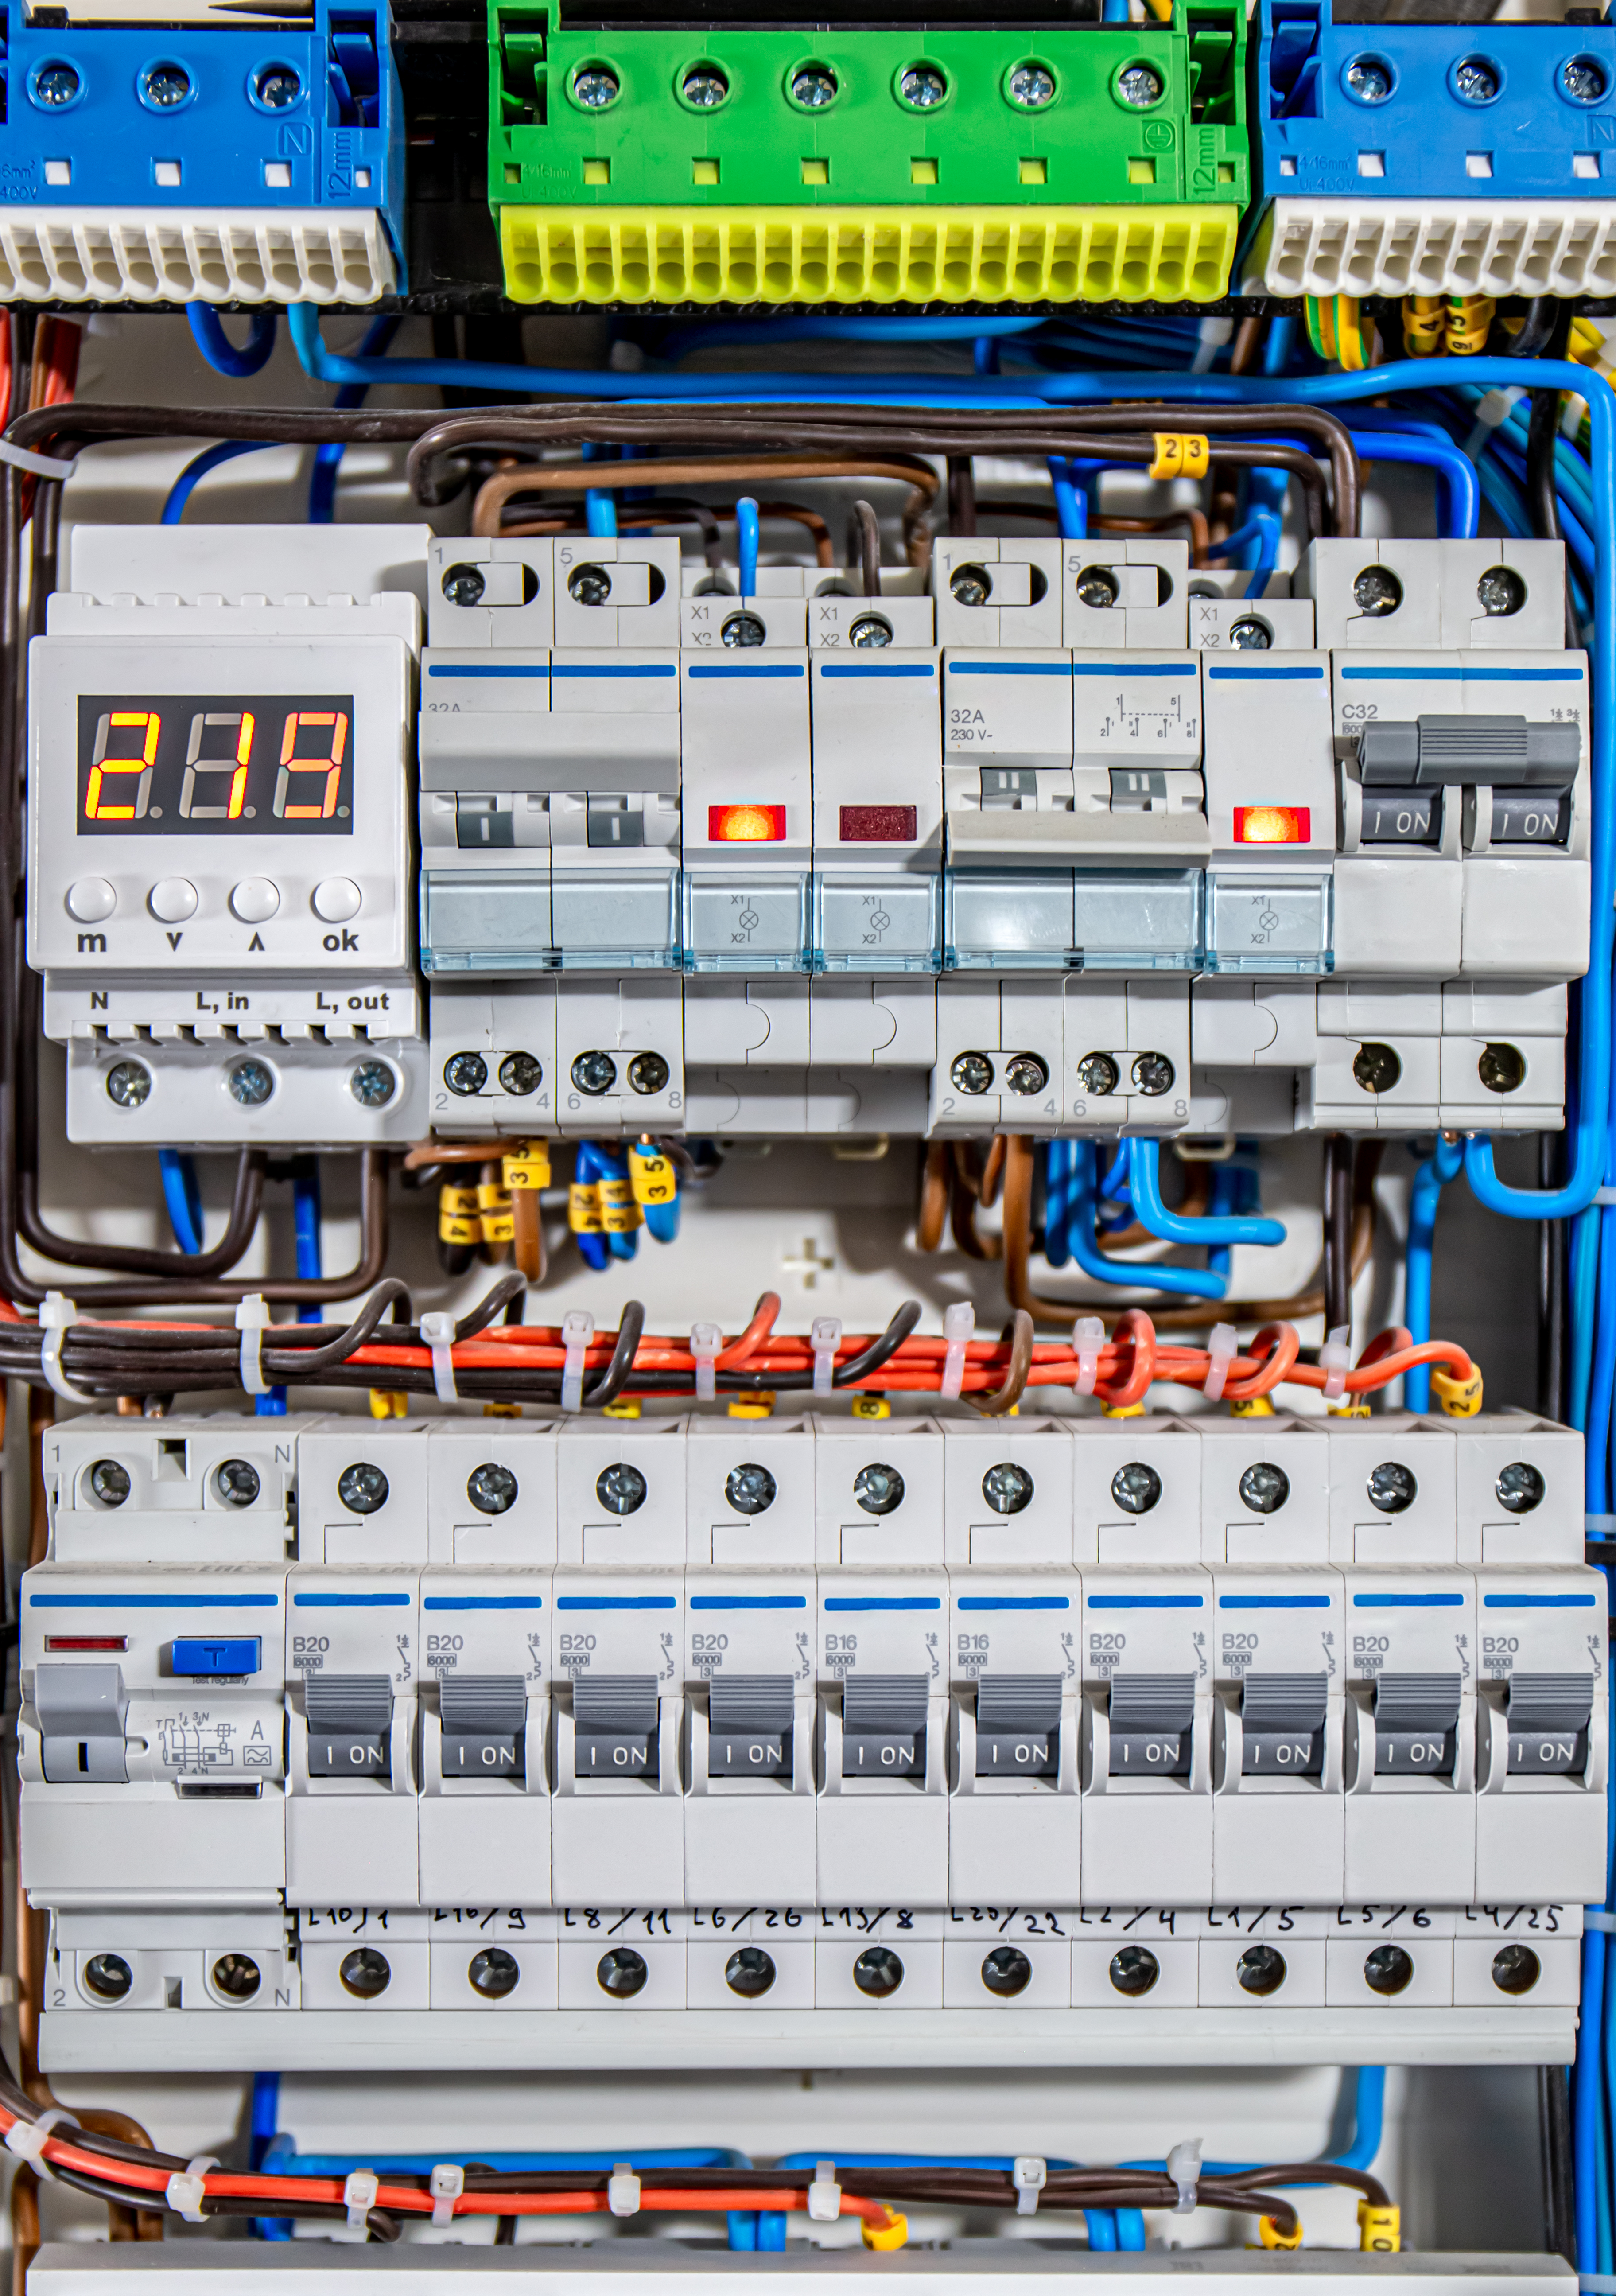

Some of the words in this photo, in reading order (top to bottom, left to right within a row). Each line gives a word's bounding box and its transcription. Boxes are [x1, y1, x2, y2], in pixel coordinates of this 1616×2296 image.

[283, 125, 307, 154] N
[328, 132, 351, 199] 12mm
[1193, 128, 1216, 195] 12mm
[435, 547, 443, 564] 1
[560, 548, 573, 564] 5
[942, 554, 951, 570] 1
[1068, 556, 1082, 572] 5
[691, 606, 709, 619] X1
[820, 607, 838, 620] X1
[1200, 607, 1218, 621] X1
[820, 633, 840, 646] X2
[1200, 633, 1220, 647] X2
[951, 709, 985, 723] 32A
[1342, 704, 1378, 719] C32
[951, 729, 974, 740] 230
[84, 712, 348, 819] 219
[1397, 812, 1430, 834] ON
[1524, 814, 1558, 836] ON
[731, 895, 744, 905] X1
[862, 896, 875, 905] X1
[1251, 895, 1265, 905] X1
[77, 934, 107, 952] m
[322, 929, 359, 952] ok
[731, 933, 745, 943] X2
[862, 934, 877, 944] X2
[1251, 934, 1265, 944] X2
[90, 992, 109, 1009] N
[196, 992, 219, 1011] L,
[228, 992, 249, 1009] in
[316, 992, 338, 1011] L,
[347, 992, 390, 1009] out
[435, 1093, 448, 1110] 2
[536, 1093, 550, 1109] 4
[568, 1093, 581, 1110] 6
[668, 1091, 682, 1108] 8
[942, 1097, 955, 1115] 2
[1044, 1098, 1057, 1116] 4
[1073, 1099, 1087, 1117] 6
[1174, 1099, 1187, 1117] 8
[52, 1445, 60, 1462] 1
[275, 1445, 290, 1463] N
[293, 1637, 329, 1652] B20
[427, 1635, 463, 1650] B20
[560, 1634, 596, 1650] B20
[692, 1634, 728, 1650] B20
[826, 1634, 857, 1650] B16
[958, 1634, 989, 1650] B16
[1090, 1634, 1126, 1649] B20
[1222, 1633, 1258, 1649] B20
[1353, 1636, 1389, 1652] B20
[1483, 1637, 1519, 1653] B20
[203, 1647, 227, 1667] T
[294, 1657, 322, 1666] 6000
[428, 1656, 455, 1666] 6000
[561, 1655, 588, 1665] 6000
[693, 1655, 720, 1665] 6000
[827, 1655, 854, 1665] 6000
[959, 1655, 986, 1665] 6000
[1091, 1654, 1118, 1664] 6000
[1224, 1654, 1251, 1664] 6000
[1355, 1657, 1382, 1666] 6000
[1484, 1658, 1511, 1667] 6000
[704, 1668, 711, 1676] 3
[837, 1668, 843, 1677] 3
[1101, 1667, 1108, 1676] 3
[1234, 1667, 1240, 1675] 3
[1365, 1669, 1372, 1678] 3
[1495, 1670, 1502, 1679] 3
[250, 1720, 264, 1740] A
[350, 1746, 384, 1764] ON
[481, 1747, 516, 1765] ON
[613, 1747, 647, 1765] ON
[749, 1745, 782, 1763] ON
[880, 1746, 915, 1765] ON
[1014, 1744, 1049, 1763] ON
[1146, 1744, 1179, 1762] ON
[1276, 1745, 1310, 1763] ON
[1410, 1744, 1444, 1762] ON
[1539, 1743, 1573, 1761] ON
[53, 1989, 66, 2007] 2
[275, 1989, 291, 2007] N
